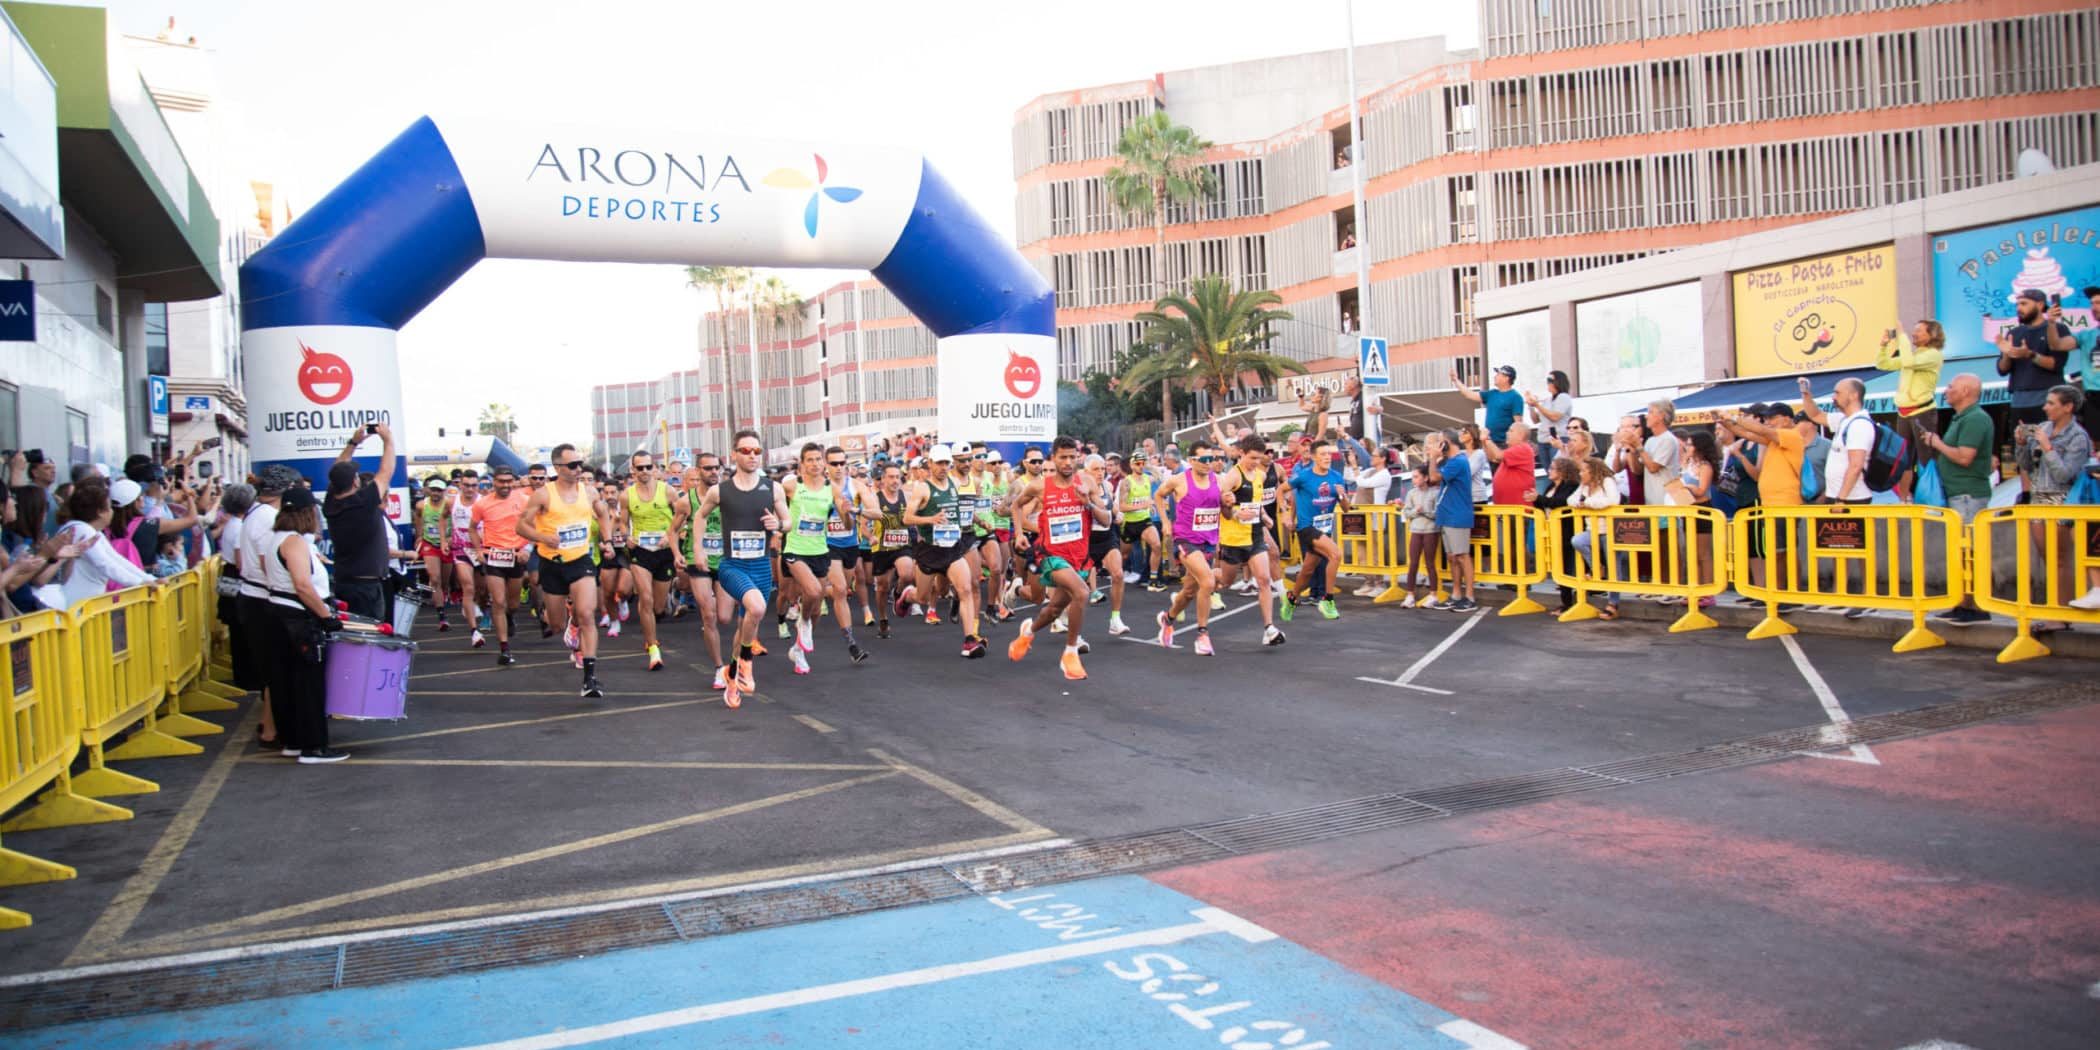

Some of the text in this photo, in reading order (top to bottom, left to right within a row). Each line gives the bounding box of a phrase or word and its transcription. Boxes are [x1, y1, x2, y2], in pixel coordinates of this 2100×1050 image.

[526, 143, 752, 194] ARONA
[562, 195, 721, 223] DEPORTES
[1958, 223, 2100, 280] Pasteler
[1747, 251, 1882, 290] Pizza Pasta Frito
[153, 380, 167, 410] P
[264, 409, 390, 432] JUEGO LIMPIO
[971, 403, 1021, 419] JUEGO
[296, 435, 327, 447] dentro
[331, 438, 336, 450] y
[738, 539, 761, 549] 152
[1103, 953, 1332, 1050] OTOS
